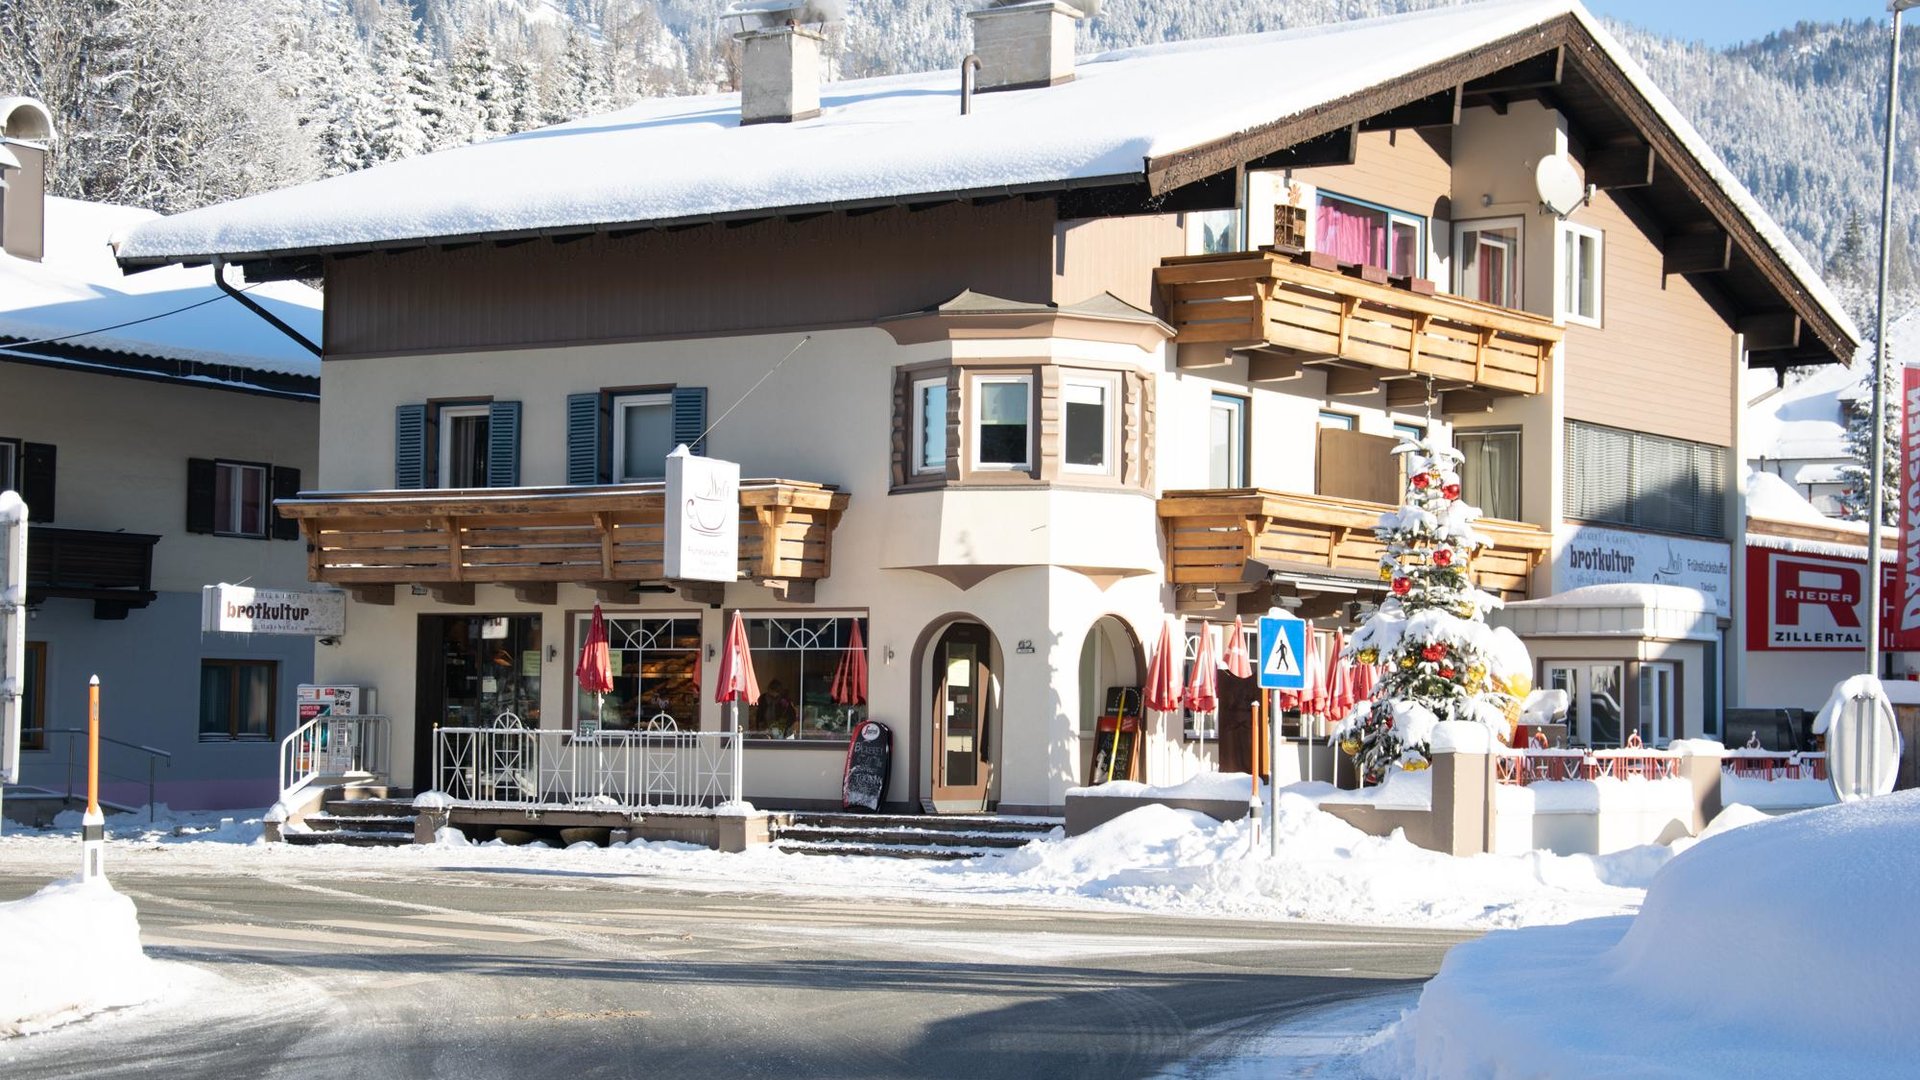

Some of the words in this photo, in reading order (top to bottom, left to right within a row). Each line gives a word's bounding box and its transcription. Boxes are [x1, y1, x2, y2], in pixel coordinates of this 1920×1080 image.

[1570, 544, 1635, 573] brotkultur
[1785, 589, 1853, 603] RIEDER
[226, 601, 309, 621] brotkultur
[1775, 631, 1863, 643] ZILLERTAL
